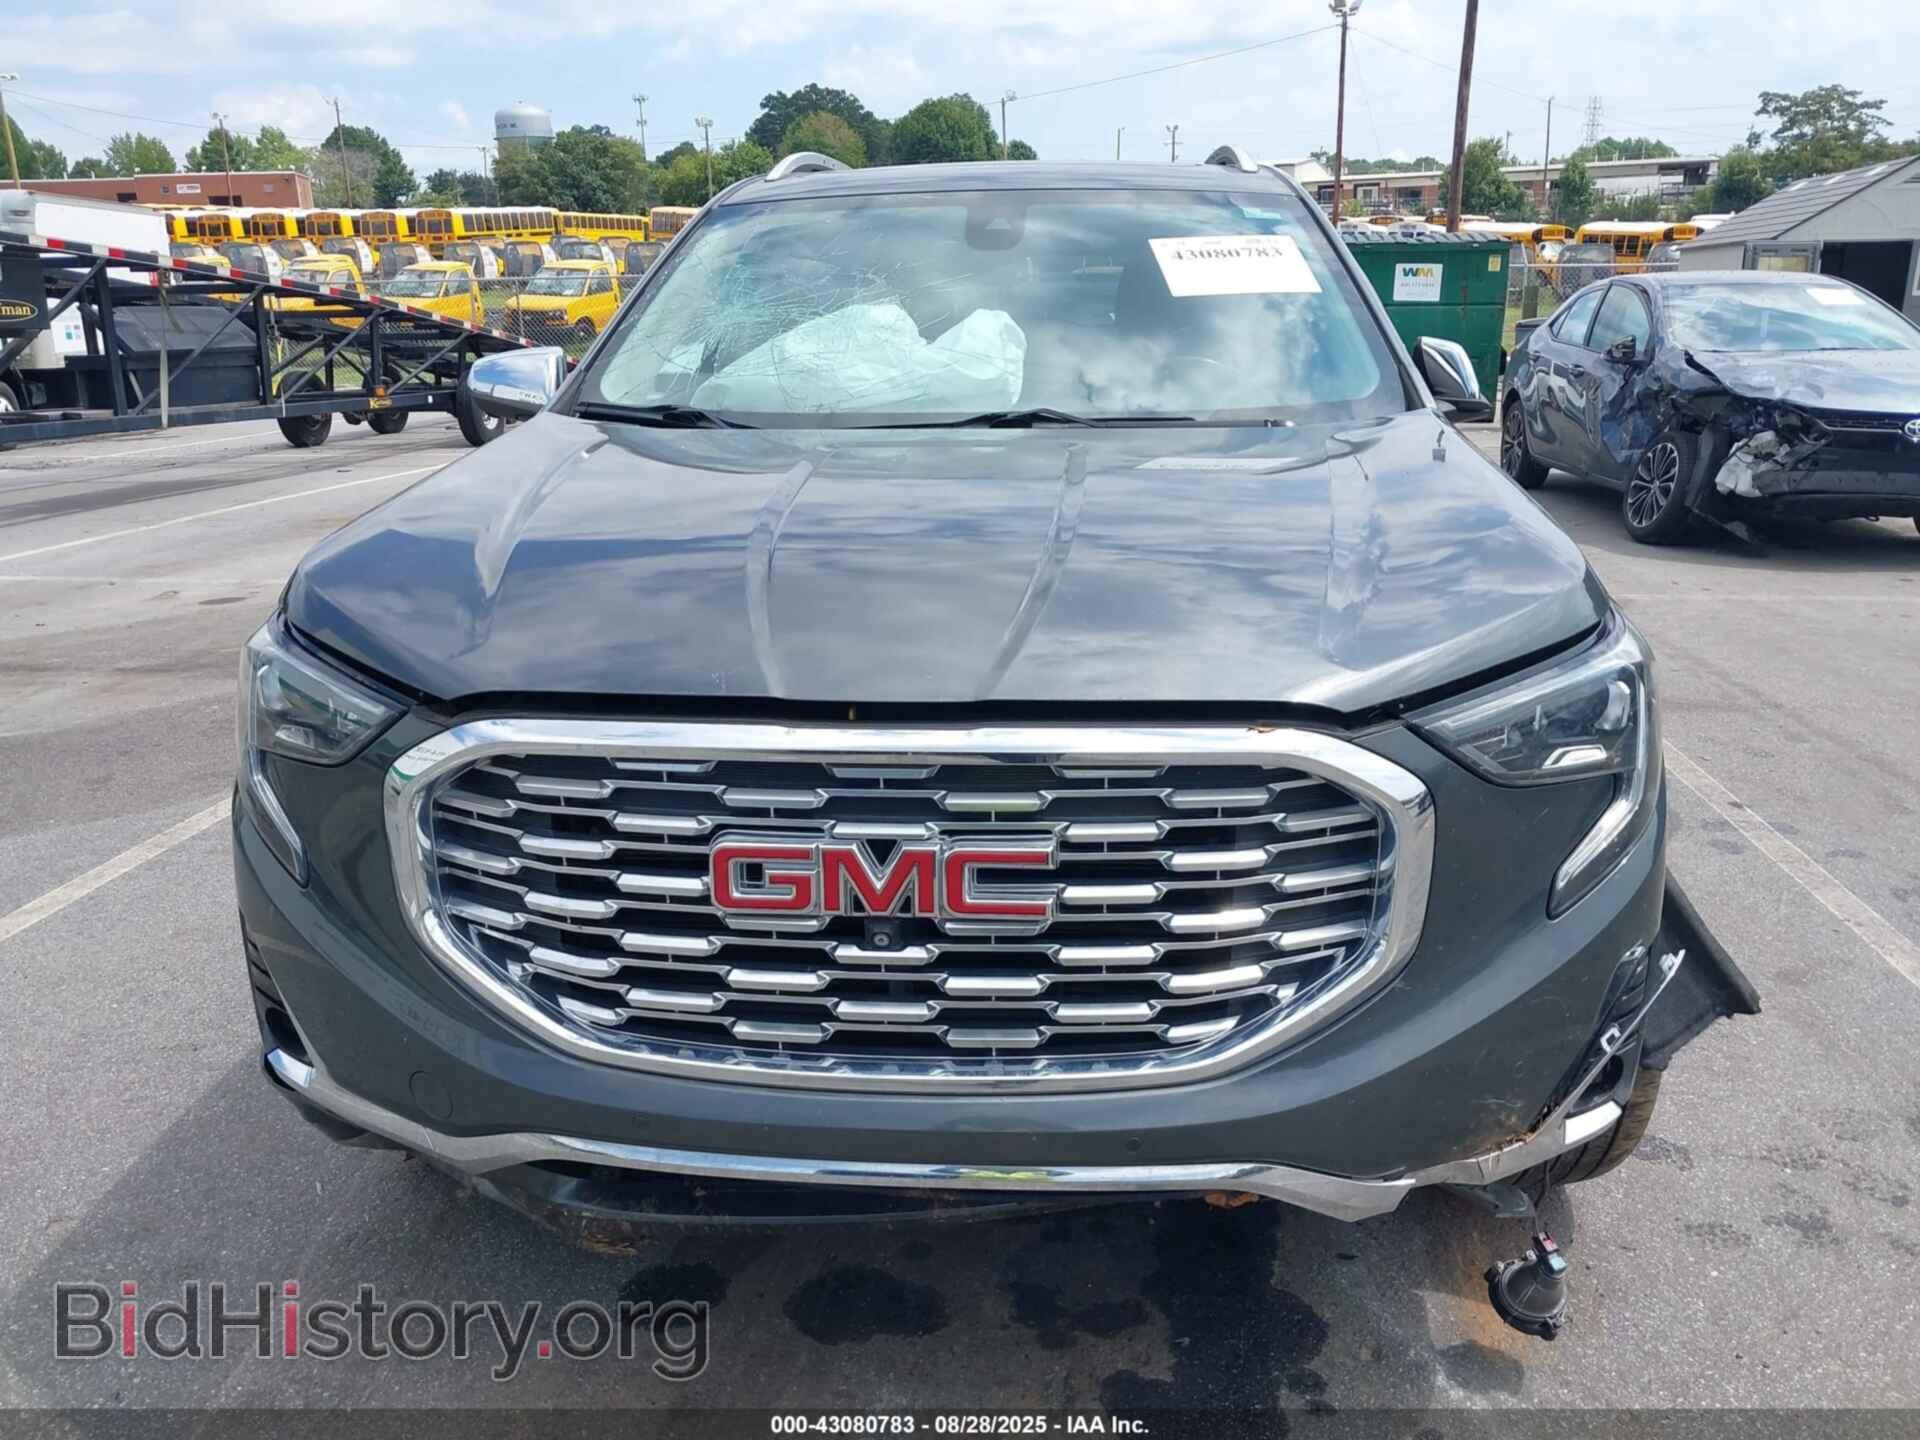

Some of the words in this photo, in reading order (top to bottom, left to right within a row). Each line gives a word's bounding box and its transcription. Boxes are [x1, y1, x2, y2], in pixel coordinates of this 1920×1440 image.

[1172, 247, 1284, 260] 43080783
[1402, 267, 1433, 278] WM
[0, 302, 32, 316] man
[710, 833, 1058, 919] GMC
